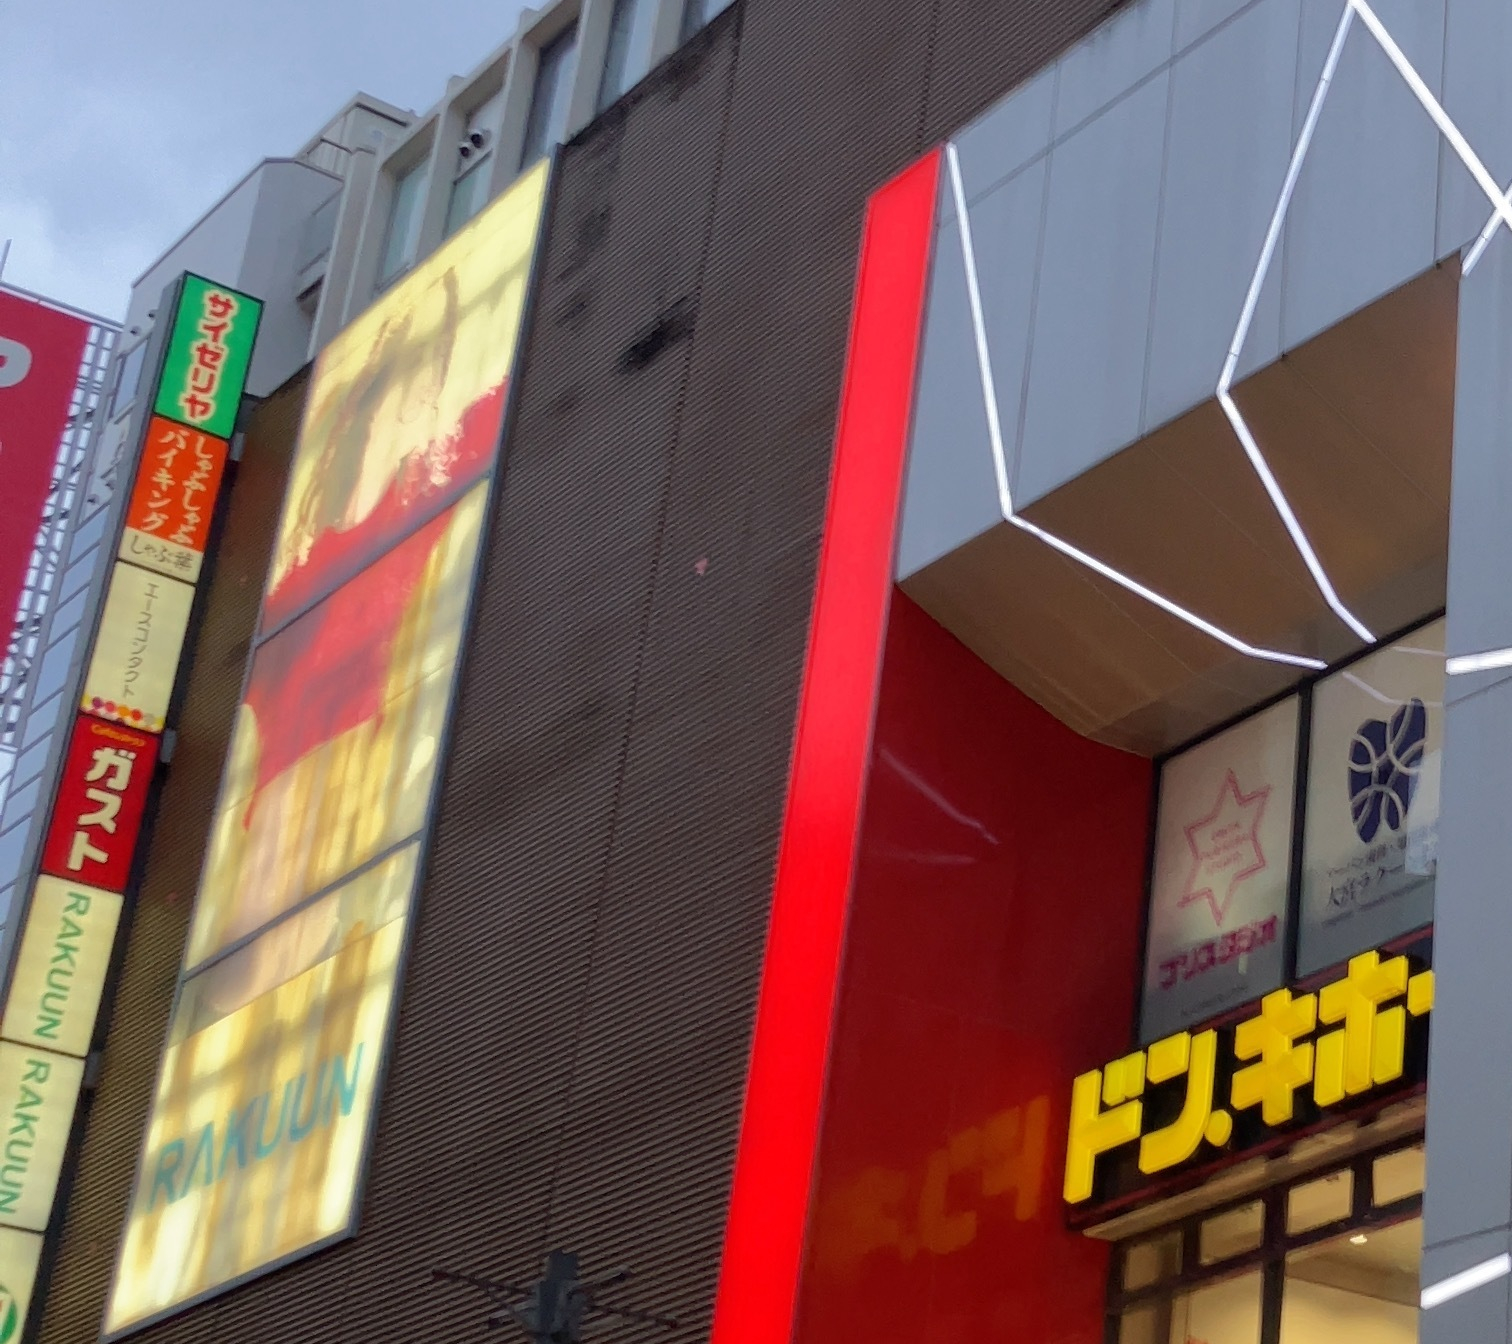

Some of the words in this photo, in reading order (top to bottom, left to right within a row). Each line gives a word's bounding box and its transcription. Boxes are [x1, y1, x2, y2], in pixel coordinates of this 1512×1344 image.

[184, 291, 236, 420] サイゼリヤ
[141, 428, 191, 532] バイキング
[122, 582, 160, 698] エースコンタクト
[67, 746, 138, 872] ガスト
[34, 889, 91, 1041] RAKUUN
[0, 1057, 50, 1216] RAKUUN
[149, 1041, 365, 1212] RAKUUN
